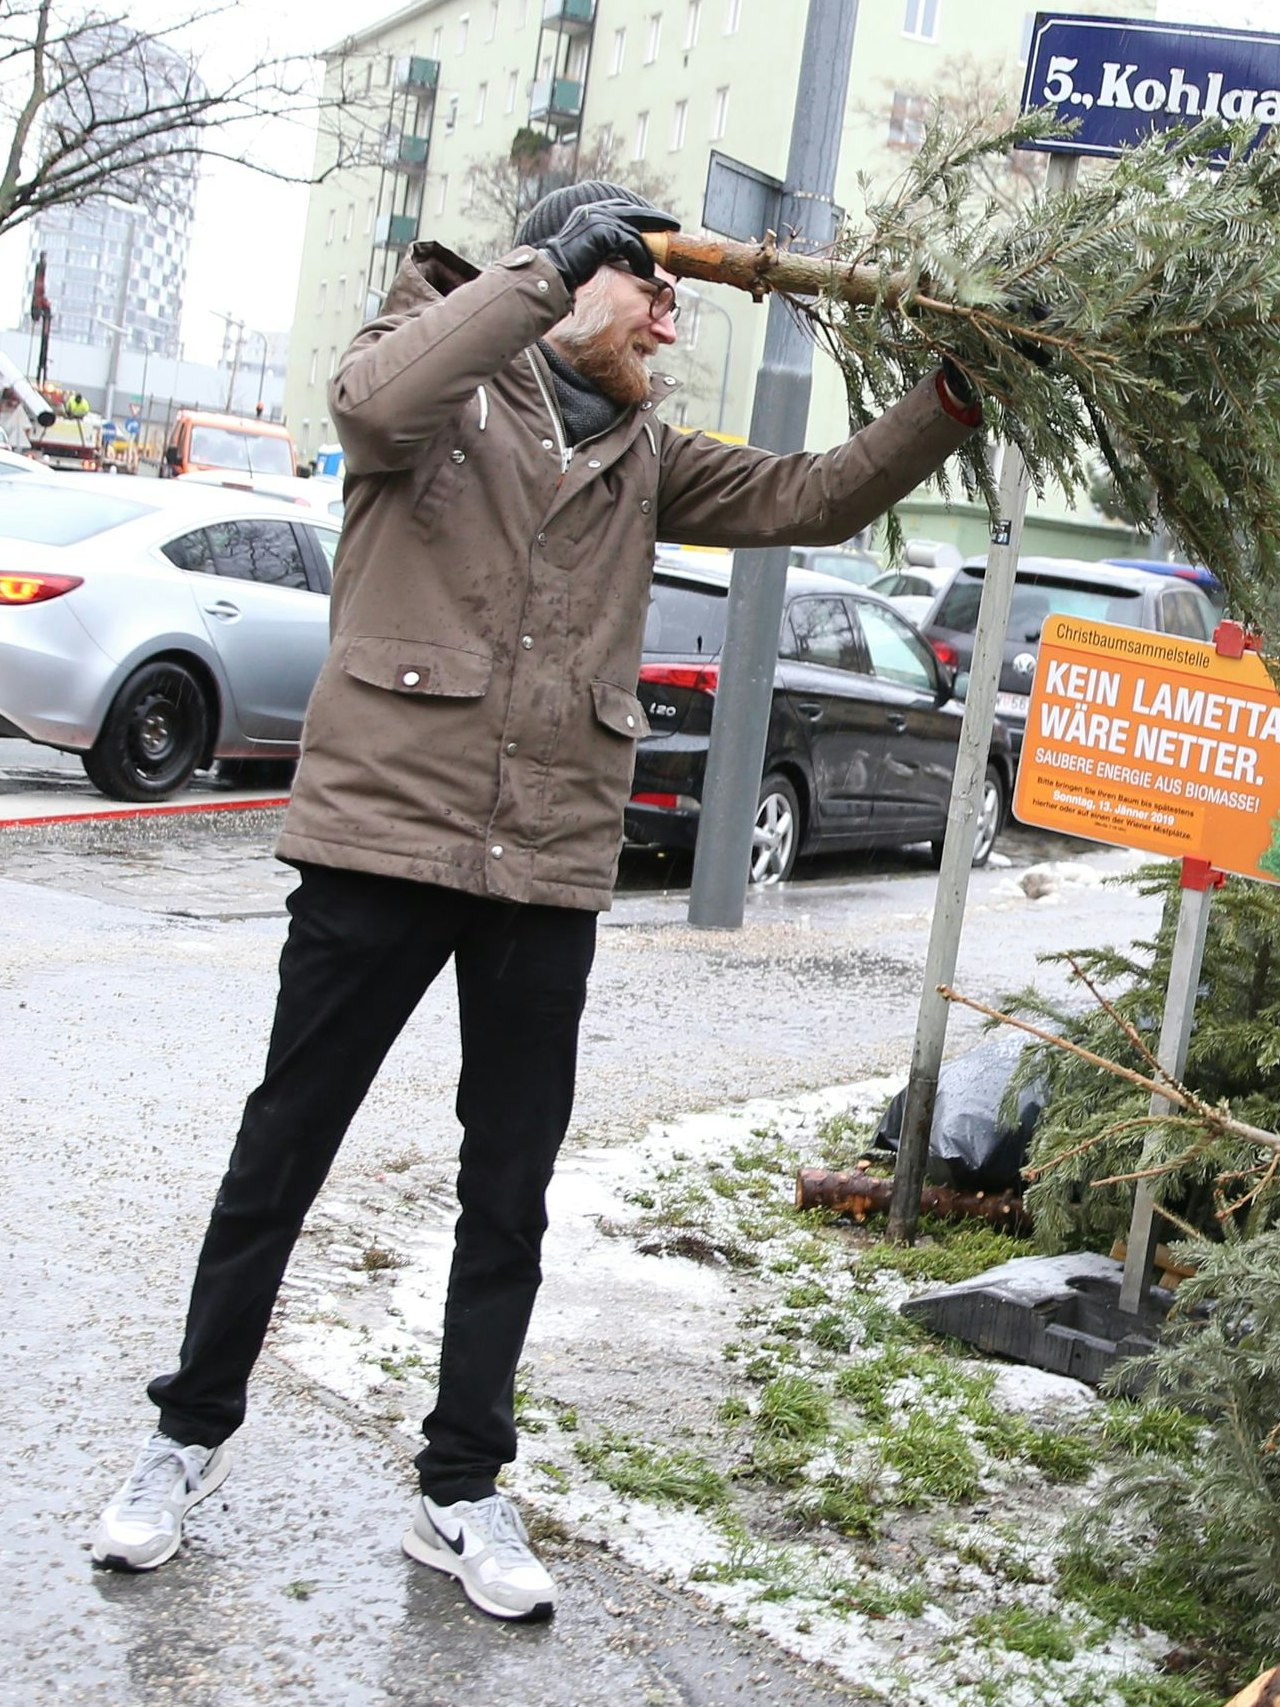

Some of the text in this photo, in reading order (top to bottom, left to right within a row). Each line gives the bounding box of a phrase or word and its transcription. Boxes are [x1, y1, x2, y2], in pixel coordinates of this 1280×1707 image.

[1056, 623, 1210, 669] Christbaumsammelstelle
[1045, 660, 1121, 707] KEIN
[1041, 702, 1264, 786] WÄRE NETTER.
[1035, 747, 1260, 813] SAUBERE ENERGIE AUS BIOMASSE!
[1037, 776, 1194, 817] Bitte bringen Sie Ihren Baum bis spätestens
[1032, 798, 1058, 810] hierher
[1059, 804, 1076, 813] oder
[1090, 812, 1111, 822] einen
[1126, 819, 1151, 829] Wiener
[1153, 824, 1192, 840] Mistplätze.
[1053, 789, 1175, 826] Sonntag, 13. Jänner 2019
